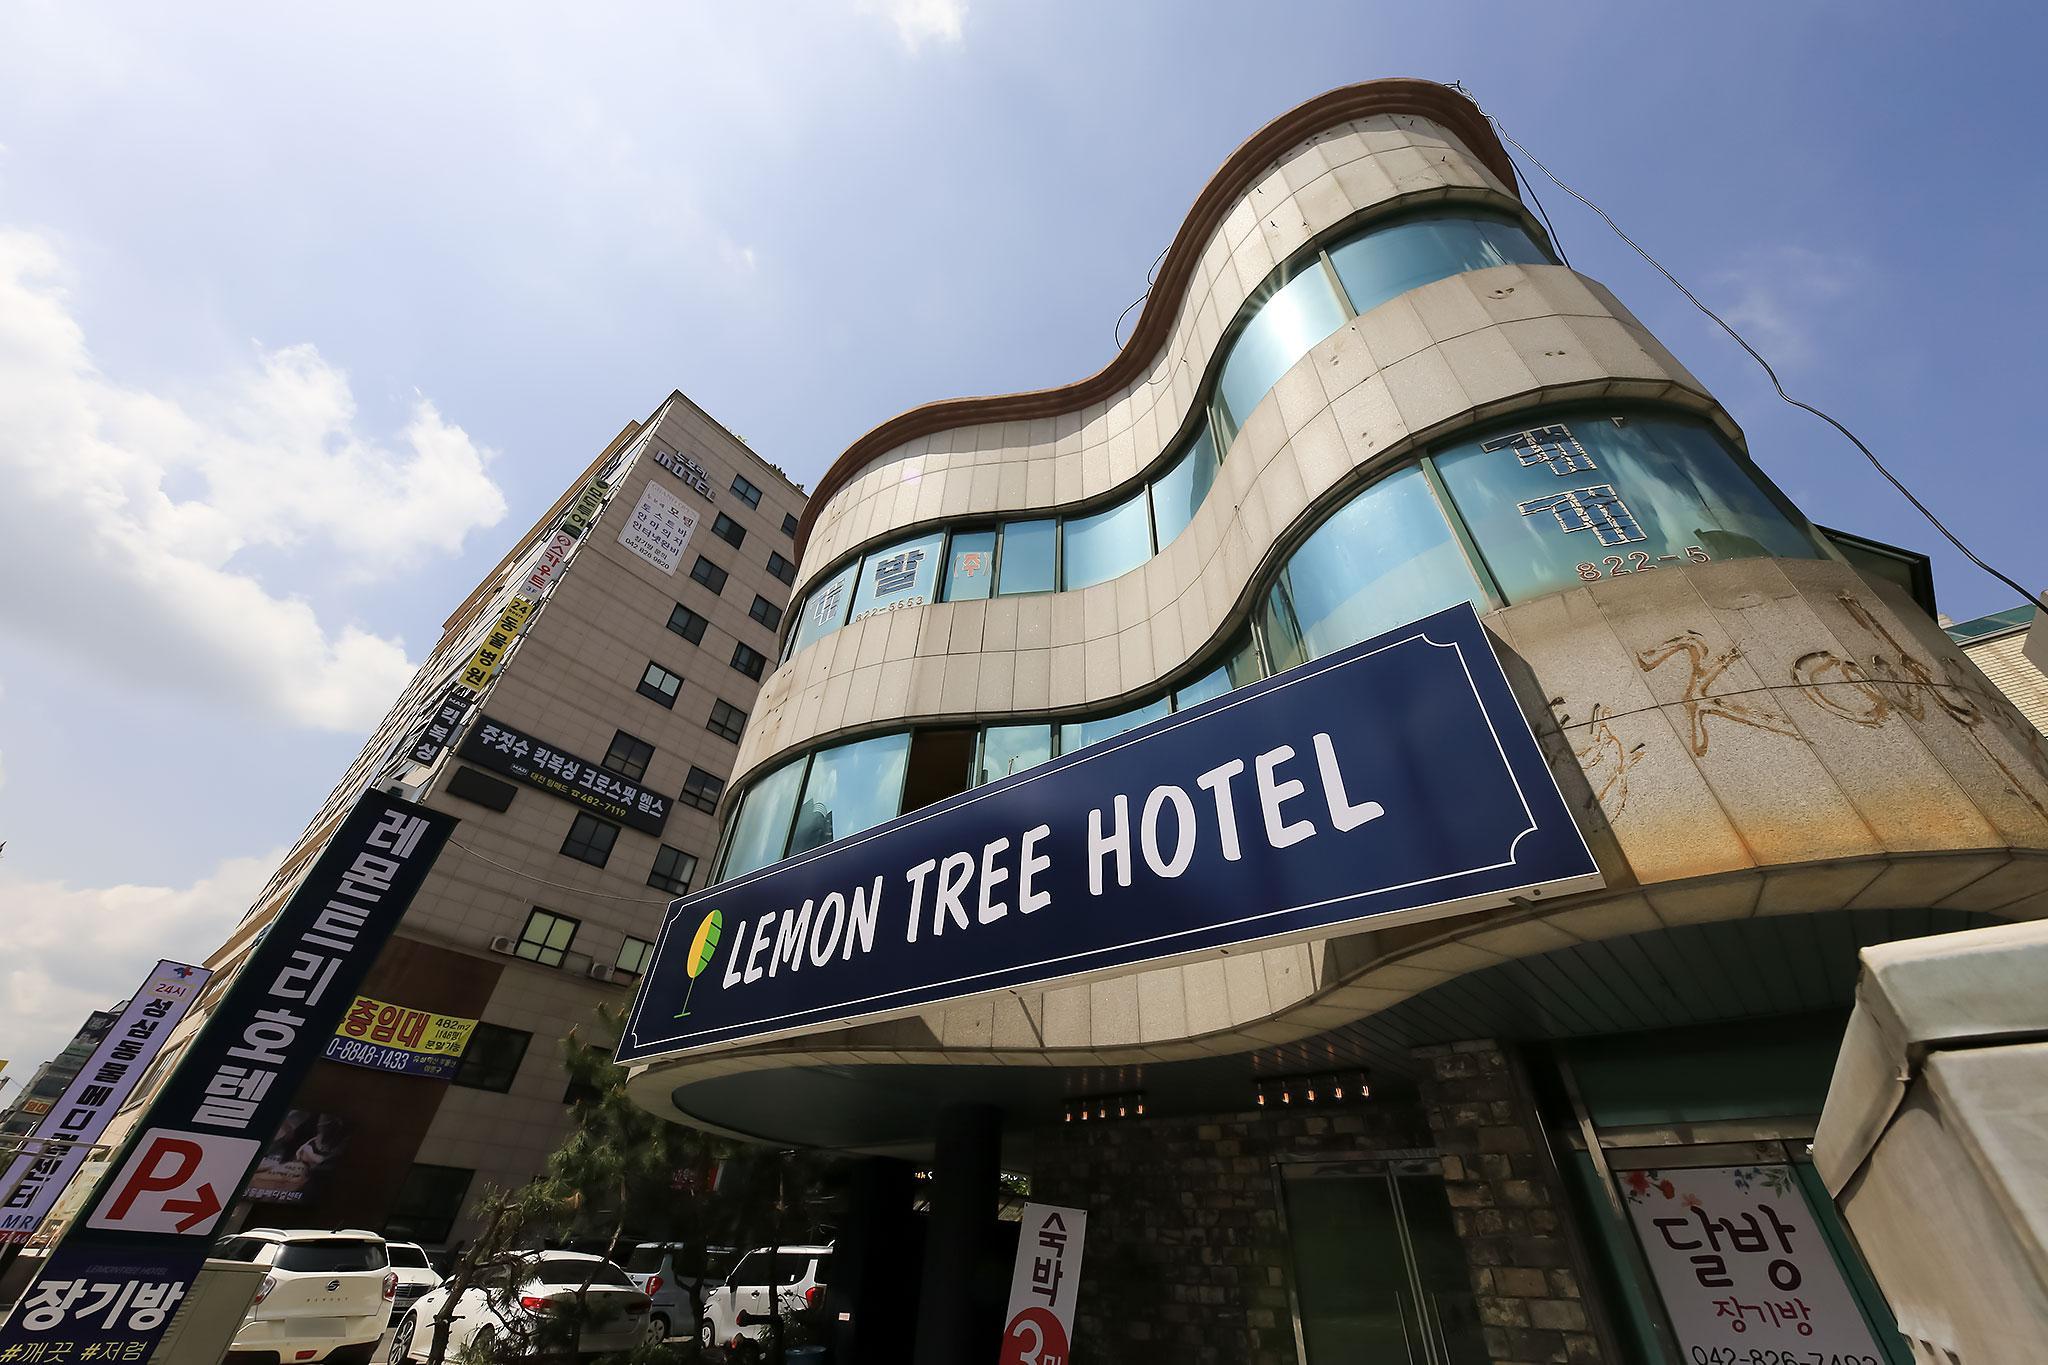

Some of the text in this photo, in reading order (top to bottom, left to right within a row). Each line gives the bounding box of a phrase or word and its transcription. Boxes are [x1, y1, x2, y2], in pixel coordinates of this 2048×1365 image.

[655, 450, 717, 503] MOTEL
[633, 521, 679, 556] 인터넷완비
[638, 511, 683, 546] 안마의자
[641, 503, 687, 537] 토스트바
[529, 545, 564, 589] 스카우트
[511, 601, 528, 615] 24
[465, 616, 519, 686] 동물병원
[416, 706, 461, 761] 킥복싱
[480, 724, 664, 818] 주짓수 킥복싱 크로스핏 헬스
[580, 793, 627, 817] 482-7119
[722, 731, 1386, 990] LEMON TREE HOTEL
[155, 983, 187, 998] 24시
[191, 808, 431, 1129] 레몬트리호텔
[105, 1137, 203, 1220] P
[1, 1214, 42, 1229] MRI
[1032, 1212, 1068, 1307] 숙박
[1653, 1203, 1802, 1291] 달방
[22, 1278, 185, 1331] 장기방
[1711, 1296, 1813, 1336] 장기방
[0, 1341, 148, 1363] #깨끗 #저렴
